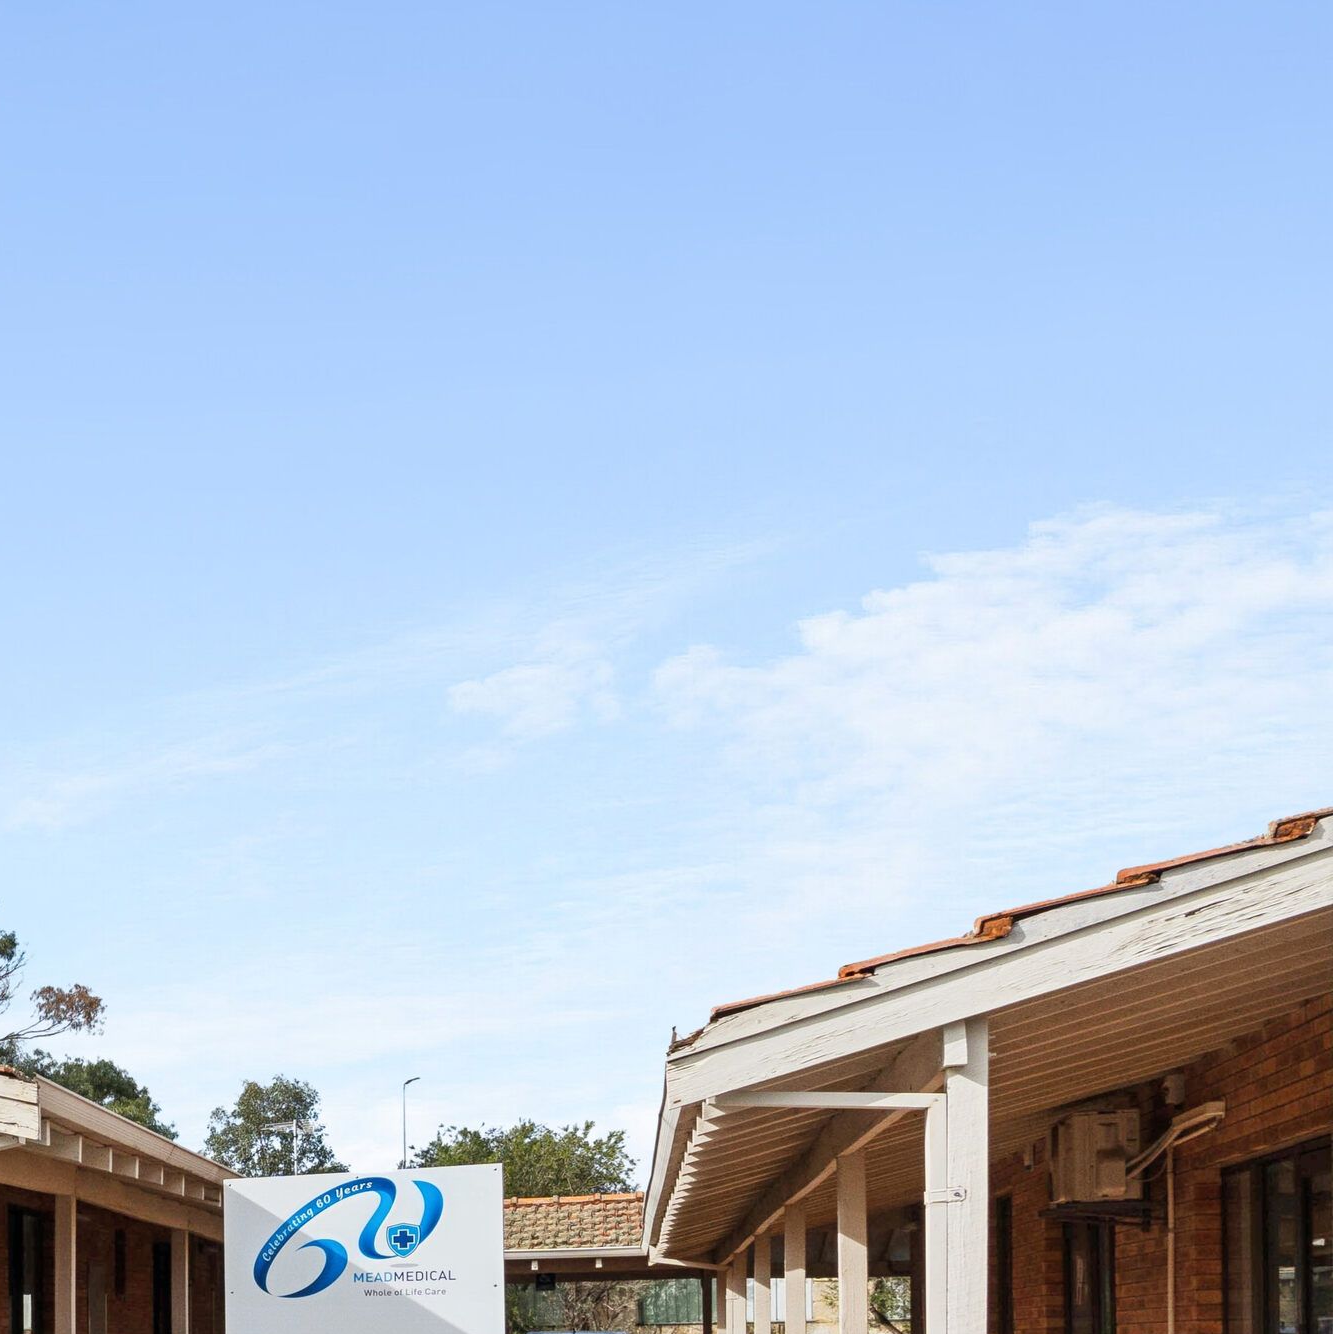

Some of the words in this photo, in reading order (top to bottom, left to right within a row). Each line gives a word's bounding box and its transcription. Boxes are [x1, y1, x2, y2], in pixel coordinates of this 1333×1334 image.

[262, 1207, 314, 1262] Celebrating
[316, 1194, 331, 1209] 60
[335, 1181, 373, 1200] Years
[353, 1270, 456, 1283] MEADMEDICAL
[363, 1289, 392, 1297] Whole
[405, 1288, 423, 1296] Life
[424, 1288, 447, 1296] Care
